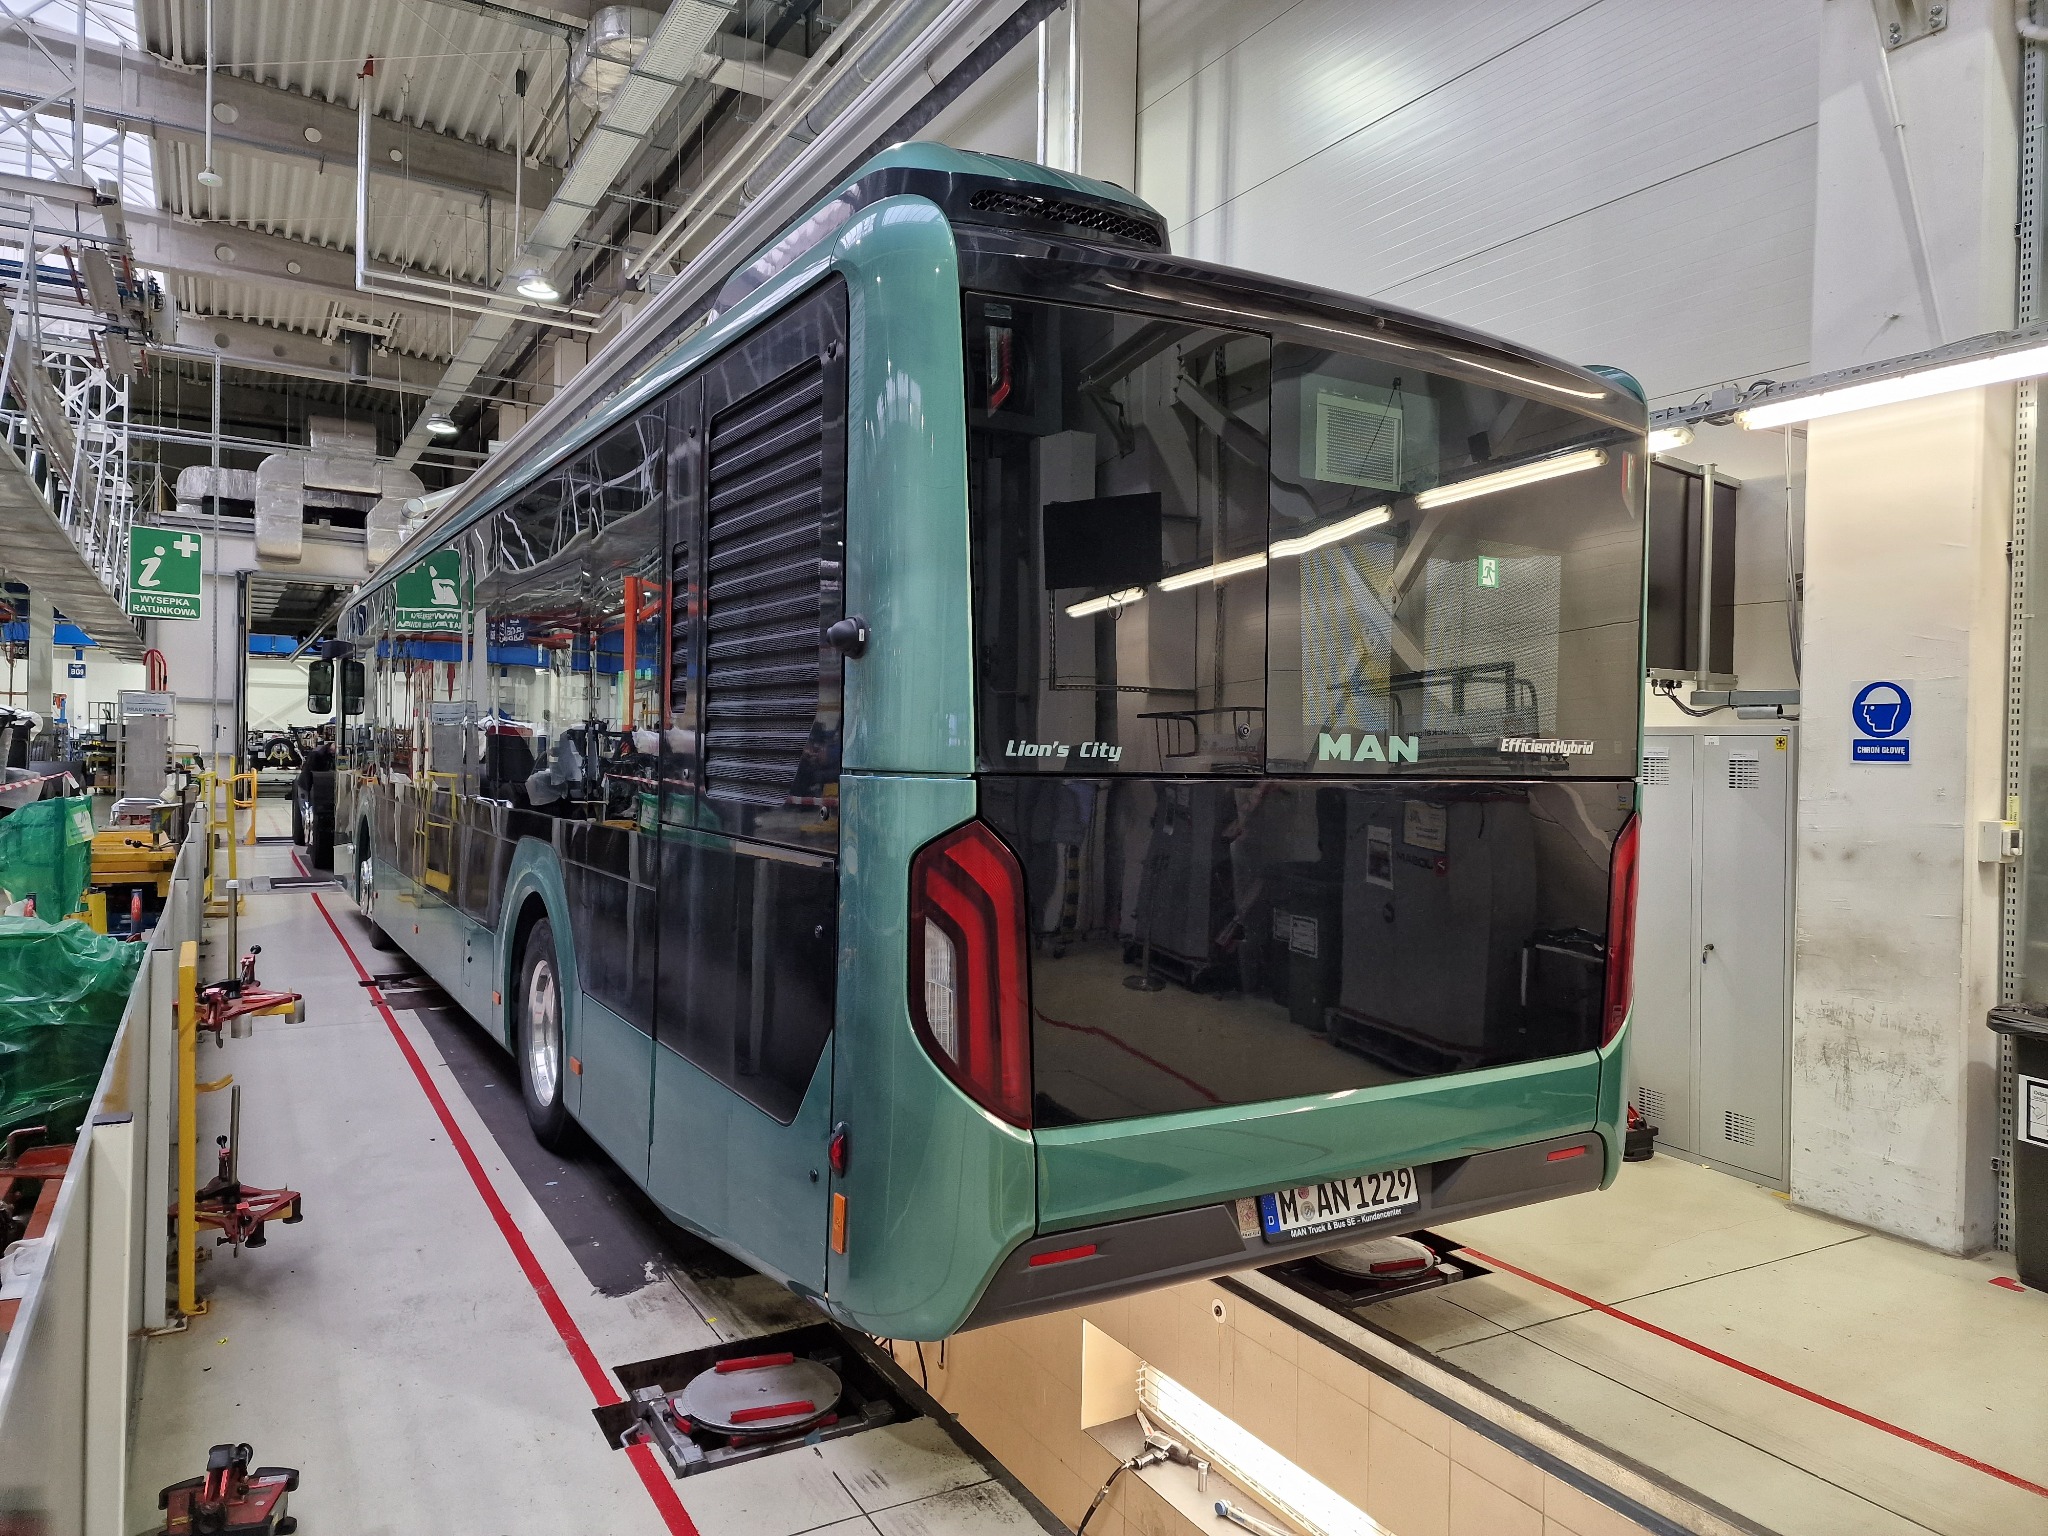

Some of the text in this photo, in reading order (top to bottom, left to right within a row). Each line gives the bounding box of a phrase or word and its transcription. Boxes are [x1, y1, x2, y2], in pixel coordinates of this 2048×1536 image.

[132, 604, 197, 616] RATUNKOWA
[139, 595, 190, 607] WYSEPKA
[1005, 740, 1123, 762] Lion's City
[1318, 732, 1419, 763] MAN
[1500, 738, 1594, 757] EfficientHybrid
[1857, 745, 1906, 756] CHROŃ GŁOWĘ
[1278, 1188, 1299, 1225] M
[1267, 1215, 1275, 1226] D
[1290, 1227, 1307, 1238] MAN
[1308, 1225, 1326, 1234] Truck
[1327, 1223, 1332, 1231] &
[1333, 1220, 1346, 1229] Bus
[1346, 1218, 1357, 1226] SE
[1361, 1208, 1402, 1223] Kundencenter
